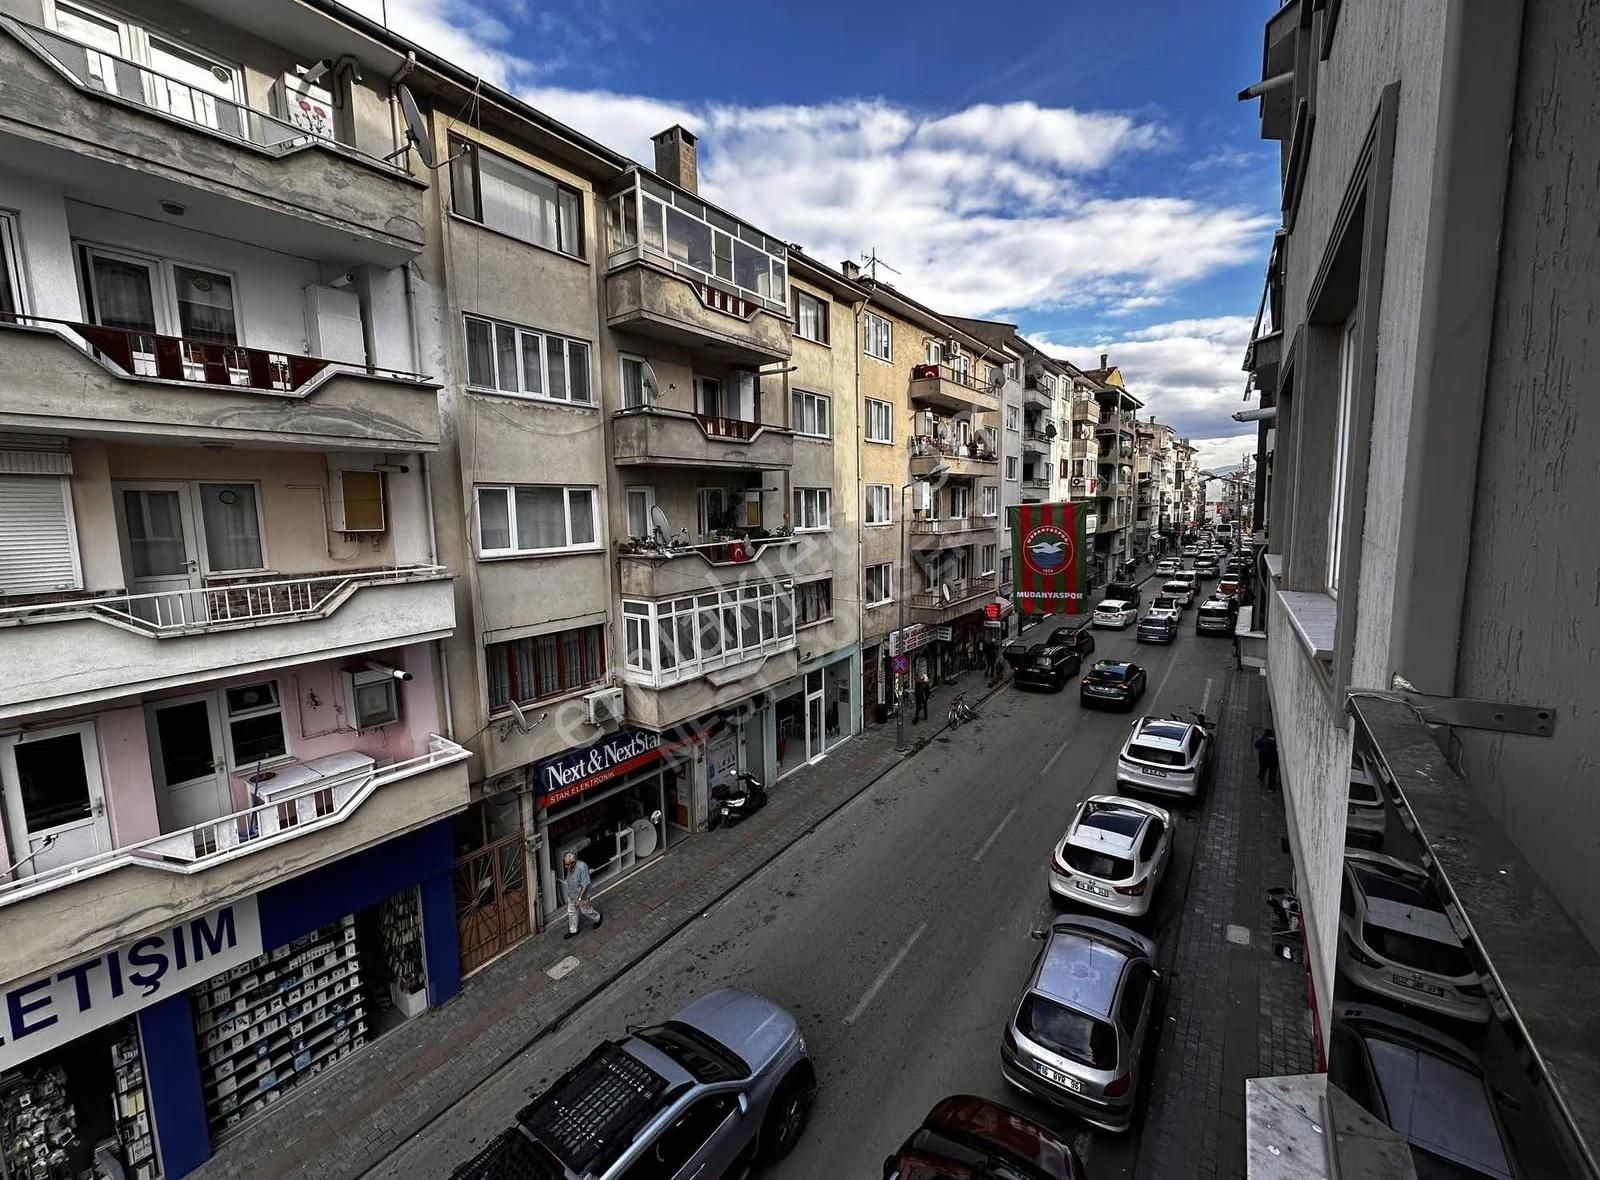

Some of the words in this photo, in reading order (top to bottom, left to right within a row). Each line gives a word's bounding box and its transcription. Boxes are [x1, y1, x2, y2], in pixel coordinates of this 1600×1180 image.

[1016, 591, 1083, 599] MUDANYASPOR
[546, 759, 586, 791] Next
[587, 749, 604, 773] &
[550, 791, 570, 803] STAR
